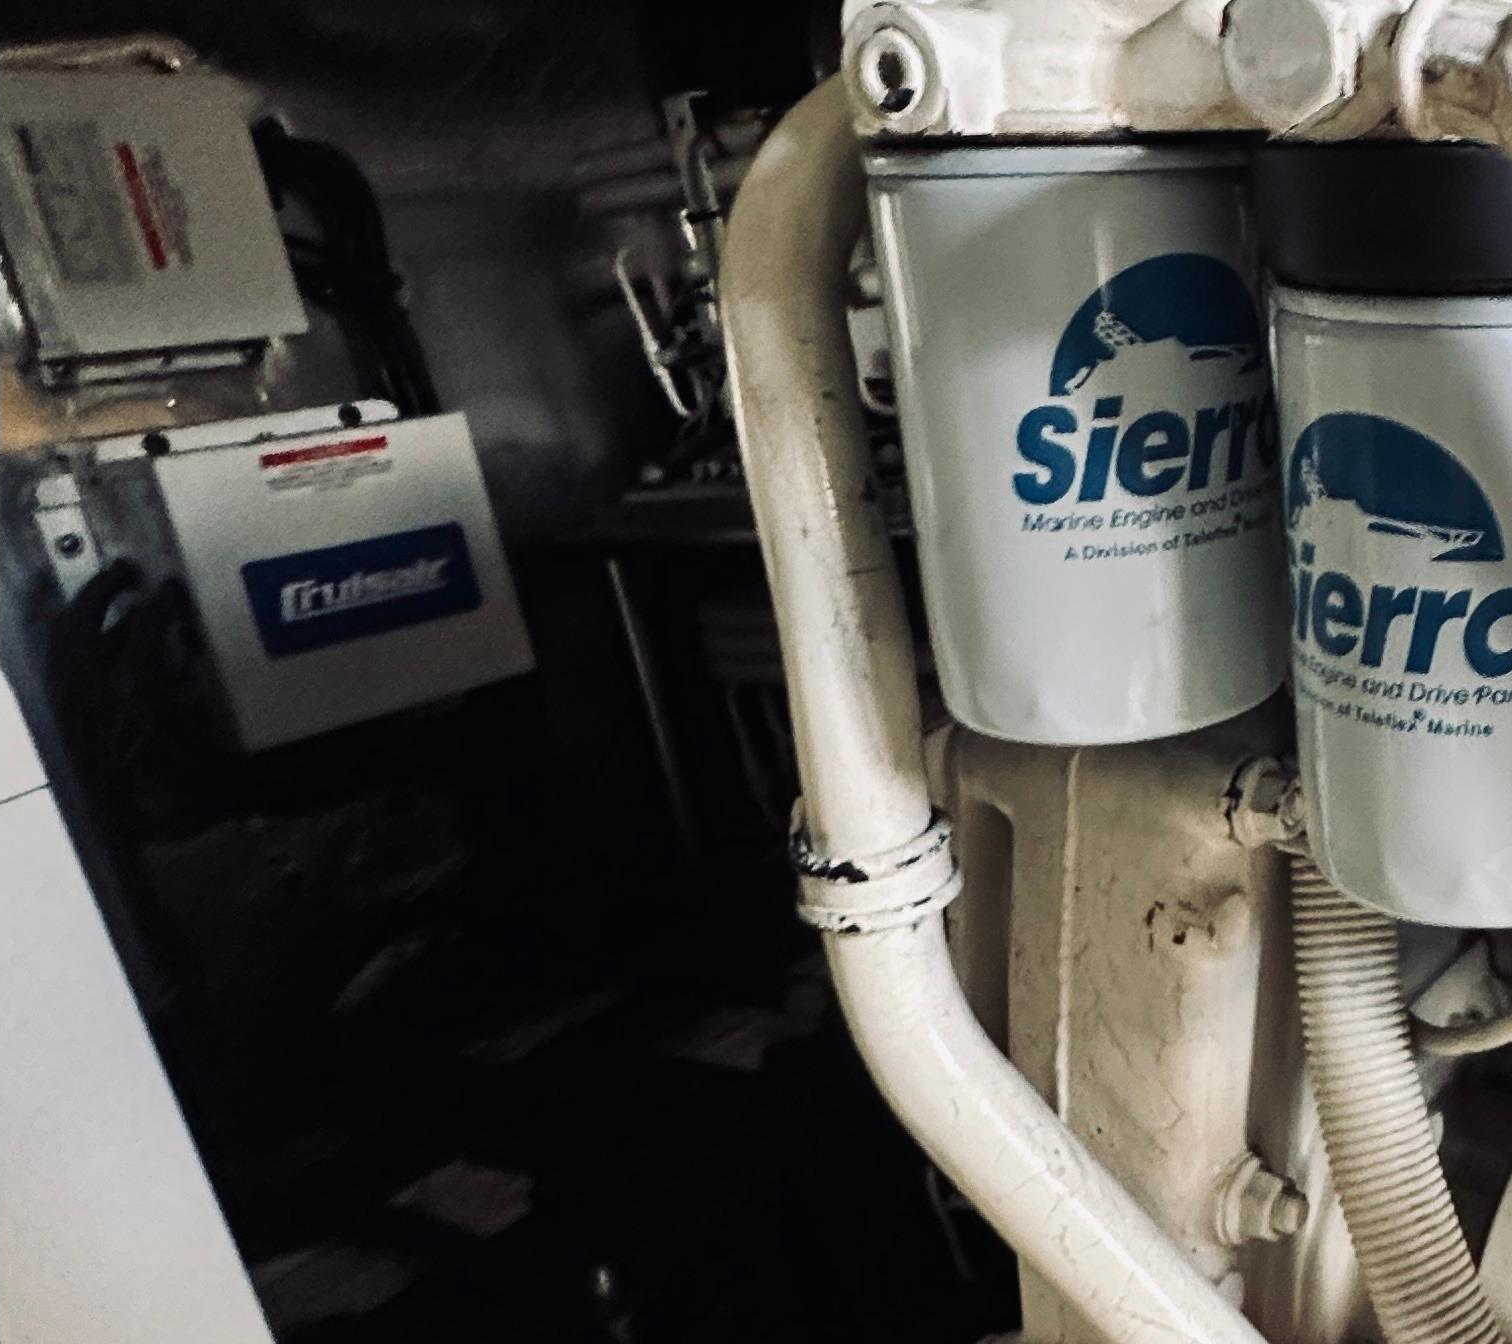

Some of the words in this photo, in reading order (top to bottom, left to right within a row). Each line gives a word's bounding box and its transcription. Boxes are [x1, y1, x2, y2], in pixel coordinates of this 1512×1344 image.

[1021, 511, 1104, 533] Marine
[1109, 501, 1187, 530] Engine
[1191, 492, 1228, 517] and
[1081, 541, 1159, 562] Division
[1161, 533, 1180, 552] of
[1360, 676, 1405, 702] and
[1407, 681, 1470, 706] Drive
